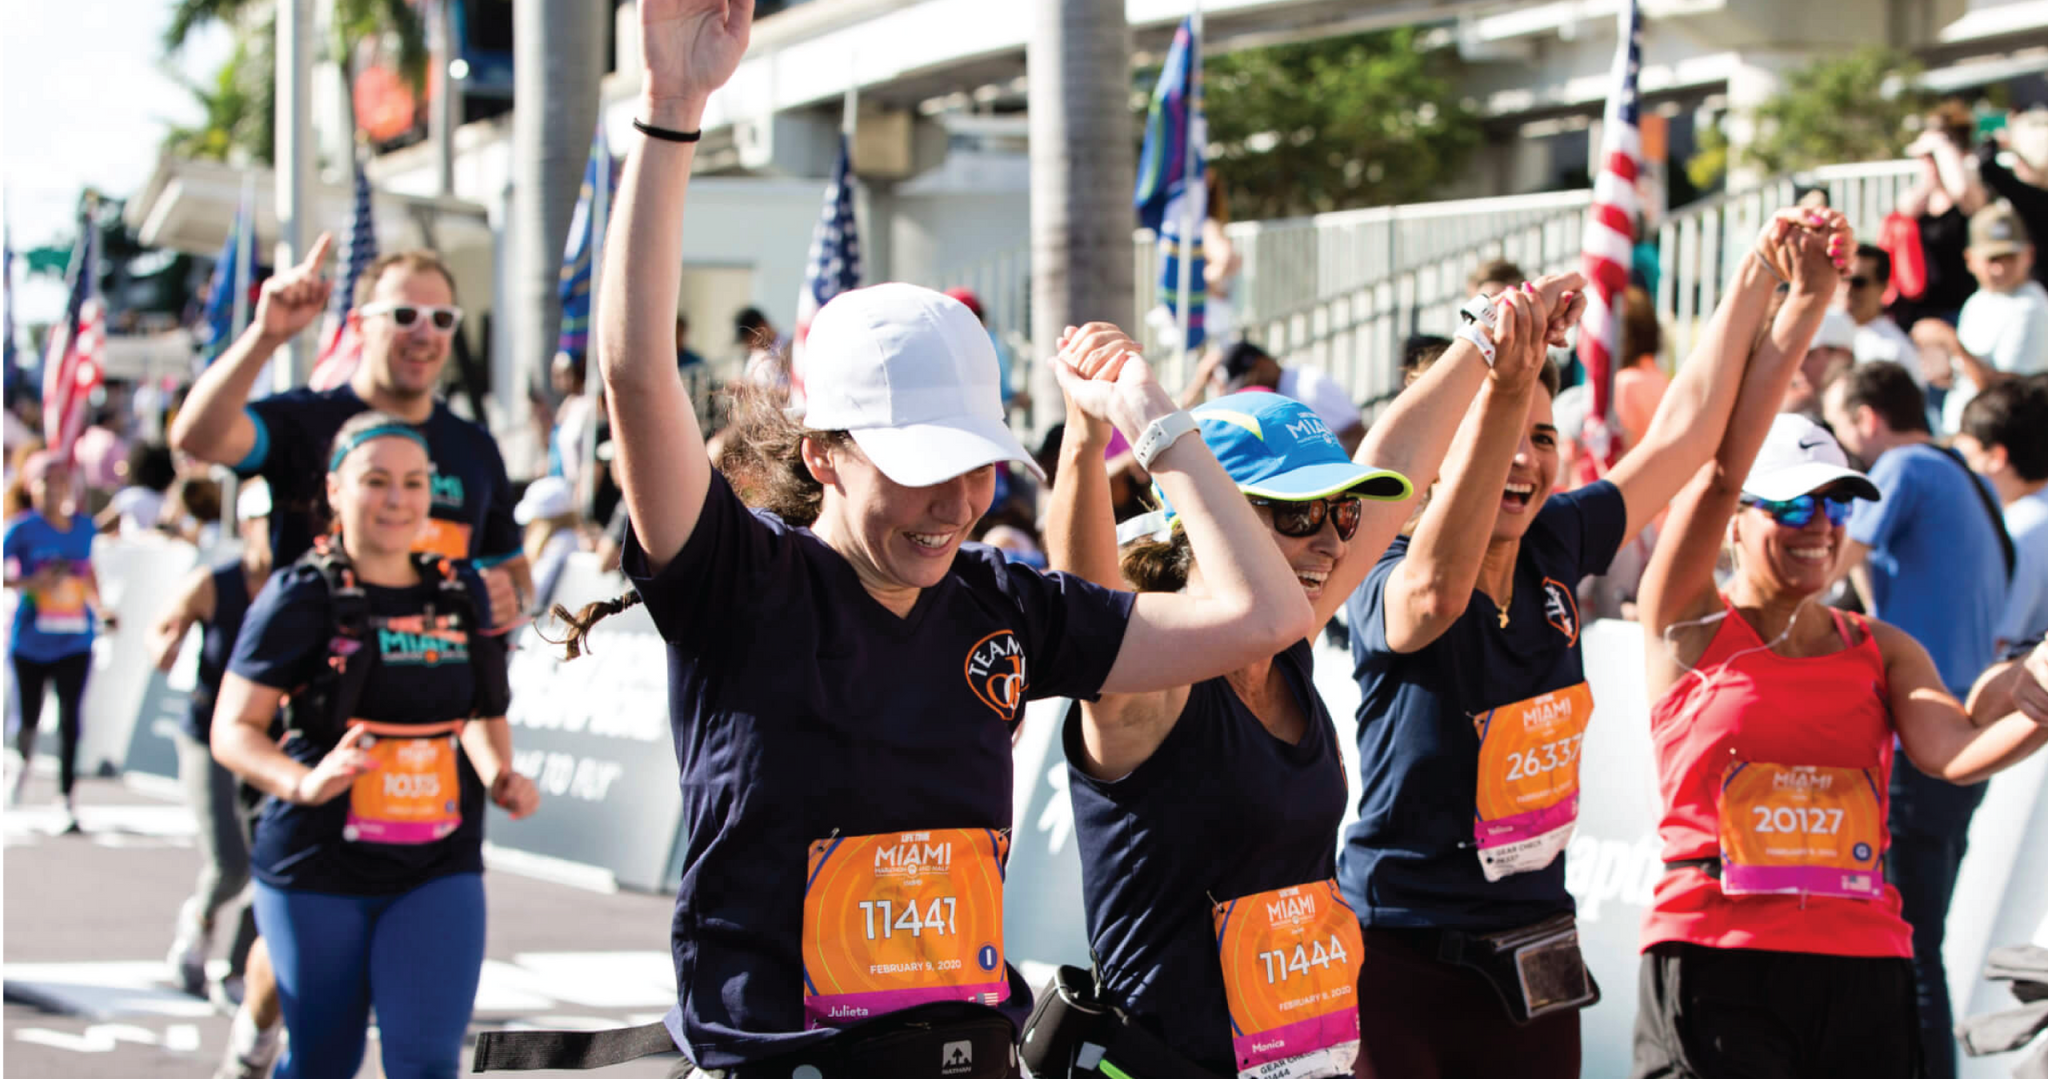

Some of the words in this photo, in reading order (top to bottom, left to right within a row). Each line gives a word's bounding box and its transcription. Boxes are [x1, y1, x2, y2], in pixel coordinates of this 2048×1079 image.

[968, 635, 1025, 676] TEAM
[1523, 697, 1572, 728] MIAMI
[1506, 732, 1583, 782] 26337
[1772, 771, 1833, 790] MIAMI
[1753, 804, 1844, 836] 20127
[875, 842, 951, 867] MIAMI
[1856, 845, 1868, 858] G
[1266, 893, 1316, 922] MIAMI
[869, 961, 924, 975] FEBRUARY
[937, 959, 962, 972] 2020
[1259, 934, 1348, 984] 11444
[828, 1004, 869, 1018] Julieta
[1251, 1039, 1285, 1053] Monica
